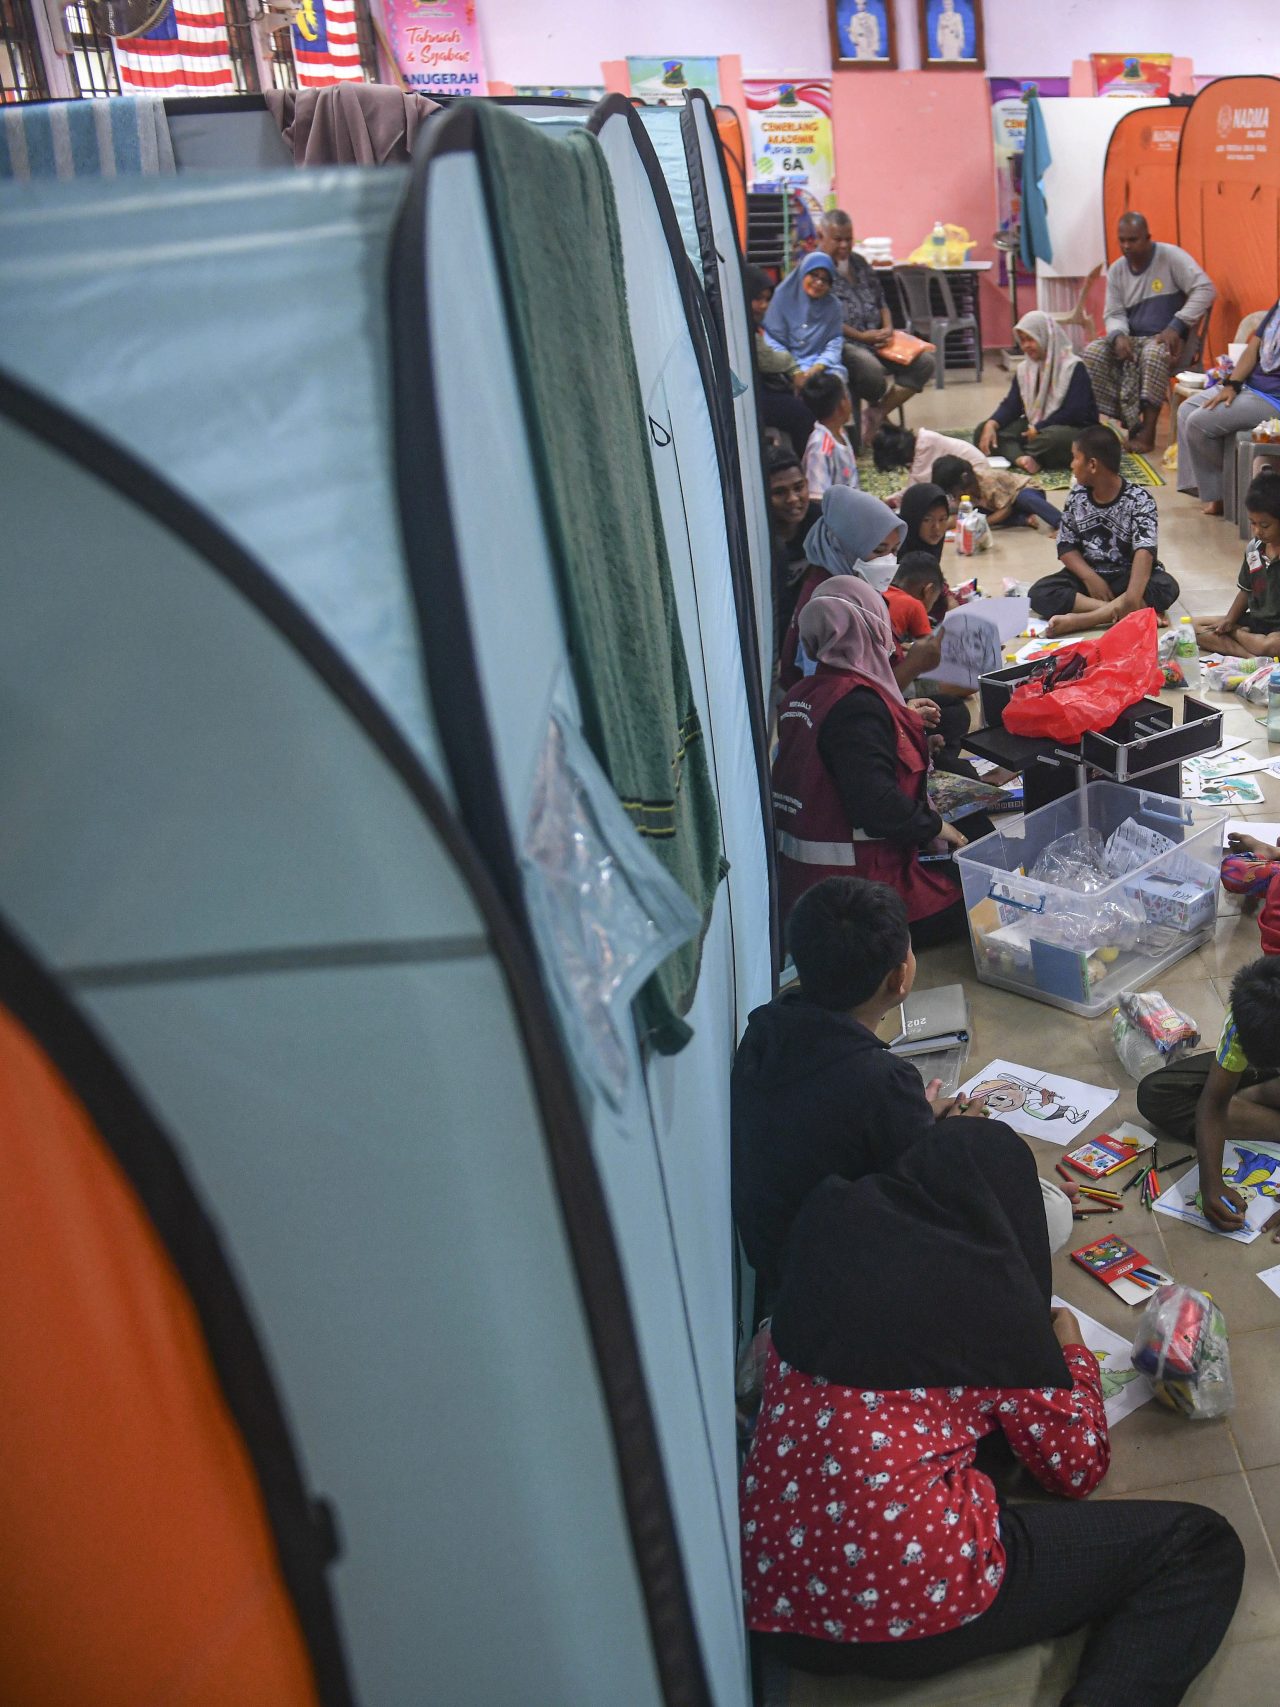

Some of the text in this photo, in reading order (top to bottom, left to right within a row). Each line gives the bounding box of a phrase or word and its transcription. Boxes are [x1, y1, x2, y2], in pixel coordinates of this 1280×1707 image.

[421, 44, 470, 67] Syabas
[402, 73, 479, 85] ANUGERAH
[1232, 106, 1270, 129] NADMA
[783, 157, 804, 171] 6A
